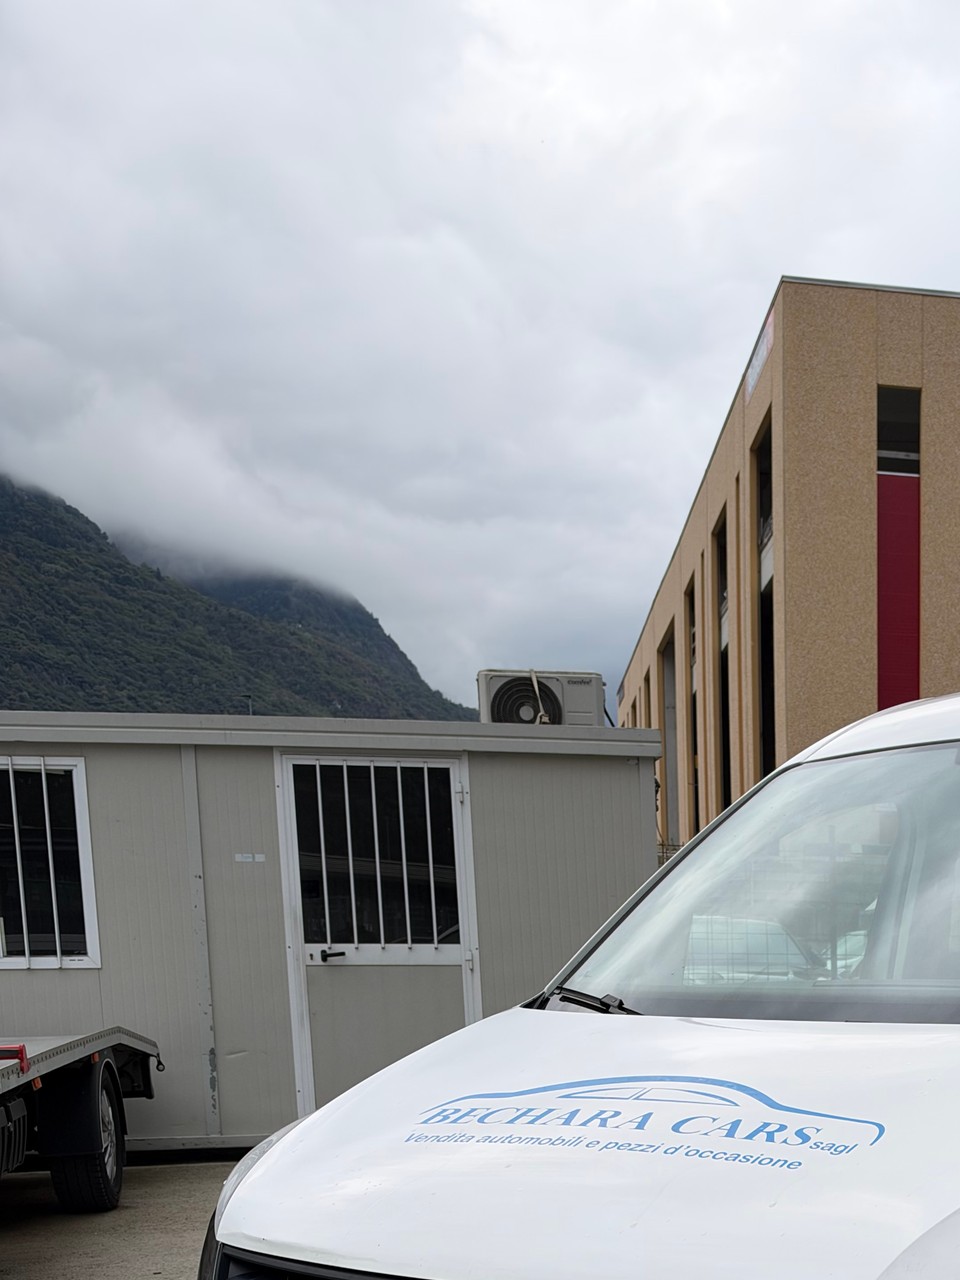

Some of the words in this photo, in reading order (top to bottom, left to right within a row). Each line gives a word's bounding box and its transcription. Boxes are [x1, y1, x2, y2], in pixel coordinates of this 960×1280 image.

[403, 1132, 475, 1144] Vendita
[475, 1133, 585, 1148] automobili
[585, 1138, 601, 1149] e
[598, 1141, 665, 1154] pezzi
[662, 1144, 803, 1171] d'occasione
[414, 1107, 654, 1131] BECHARA
[671, 1115, 823, 1147] CARS
[809, 1140, 859, 1157] sagl
